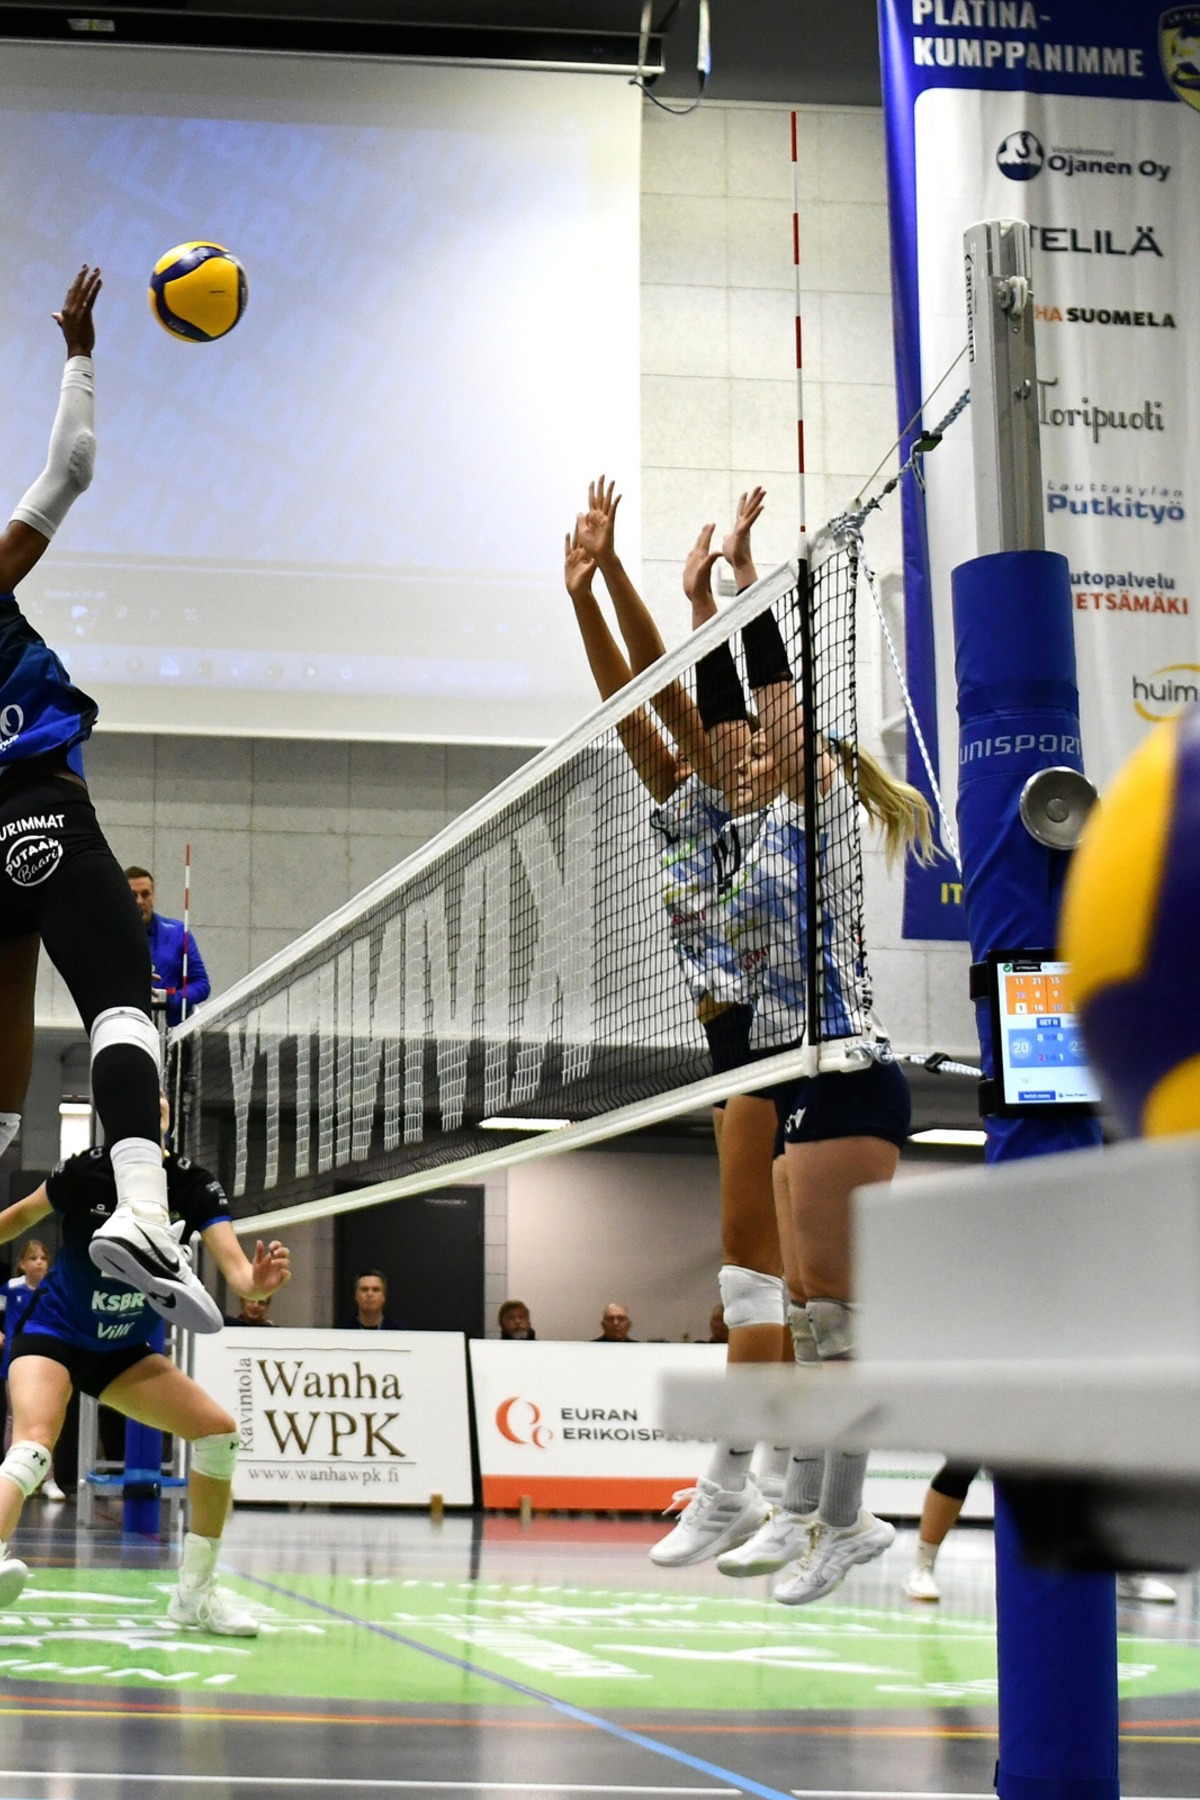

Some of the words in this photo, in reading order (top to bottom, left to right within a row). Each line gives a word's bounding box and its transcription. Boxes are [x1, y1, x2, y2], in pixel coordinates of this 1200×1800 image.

[912, 0, 1050, 30] PLATINA-
[913, 36, 1145, 77] KUMPPANIMME
[1047, 154, 1132, 177] Ojanen
[1138, 159, 1171, 182] Oy
[1035, 305, 1063, 323] HA
[1067, 306, 1177, 328] SUOMELA
[1047, 493, 1185, 525] Putkityö
[1070, 571, 1176, 590] utopalvelu
[1075, 588, 1189, 616] ETSÄMÄKI
[5, 840, 59, 877] PUTAAN
[940, 882, 963, 905] IT
[1013, 1042, 1029, 1054] 20
[91, 1289, 146, 1312] KSBR
[257, 1359, 404, 1400] Wanha
[233, 1357, 254, 1452] Ravintola
[560, 1407, 638, 1421] EURAN
[263, 1409, 406, 1457] WPK
[248, 1466, 400, 1486] www.wanhawpk.fi
